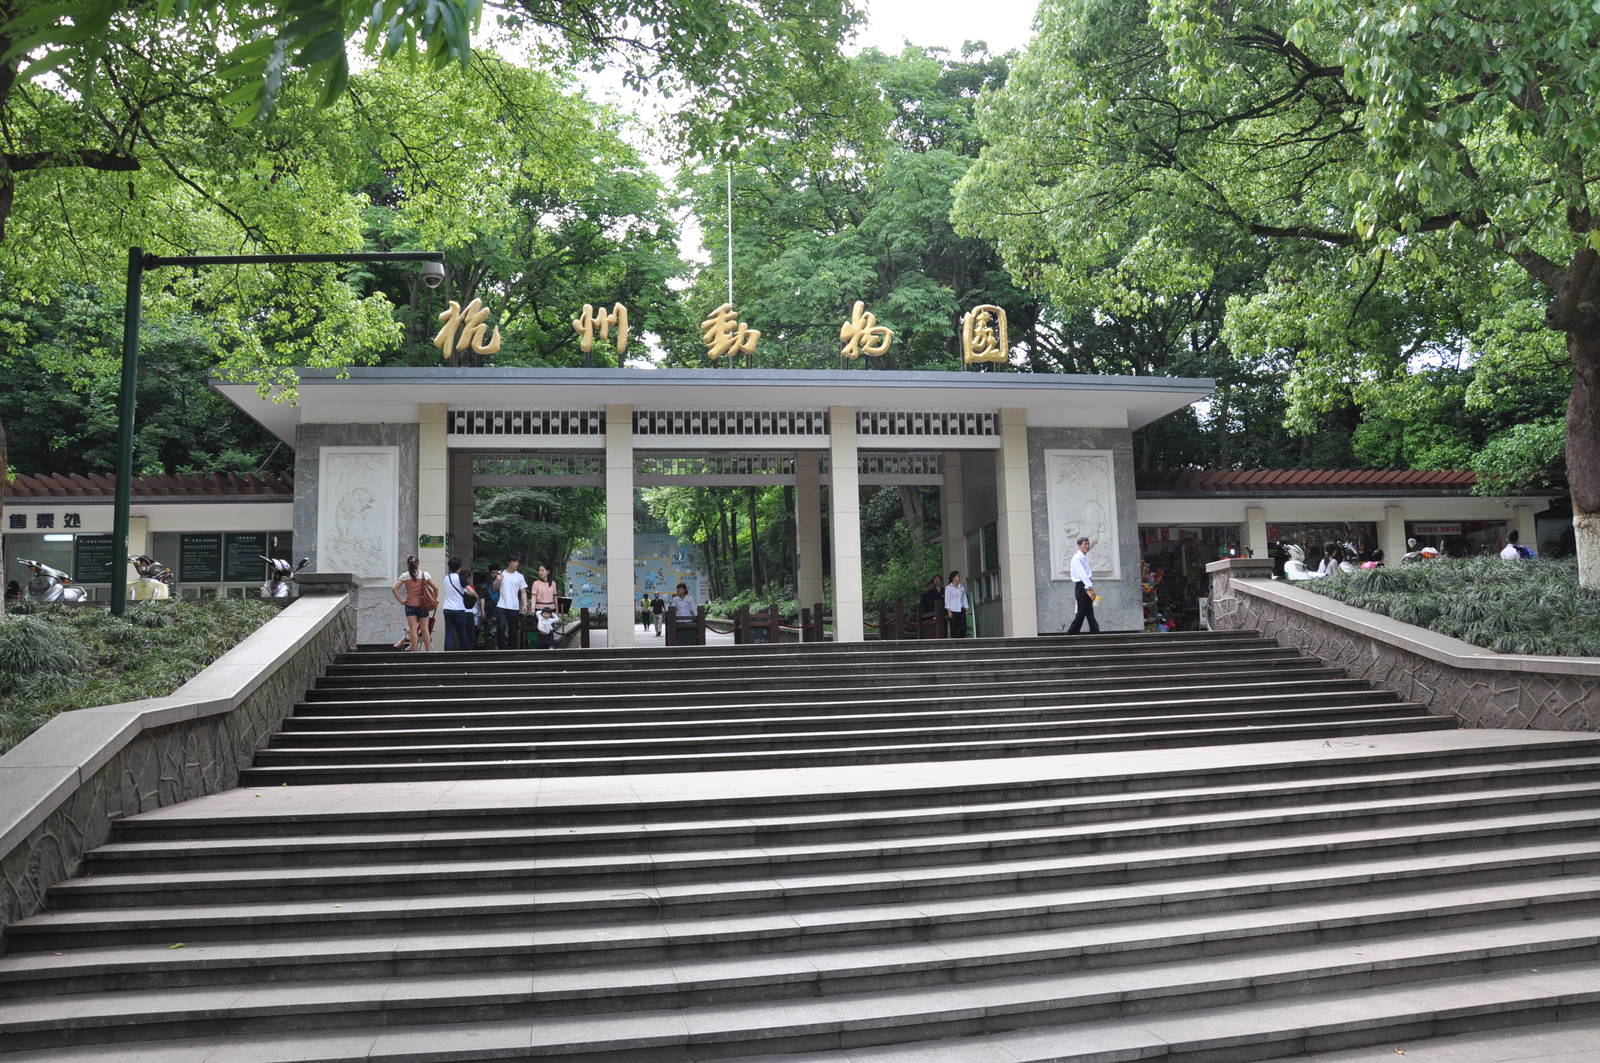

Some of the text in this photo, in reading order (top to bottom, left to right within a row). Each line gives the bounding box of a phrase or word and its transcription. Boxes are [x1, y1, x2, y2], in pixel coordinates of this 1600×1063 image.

[434, 299, 1008, 364] 杭州動物園
[9, 513, 81, 529] 售票处
